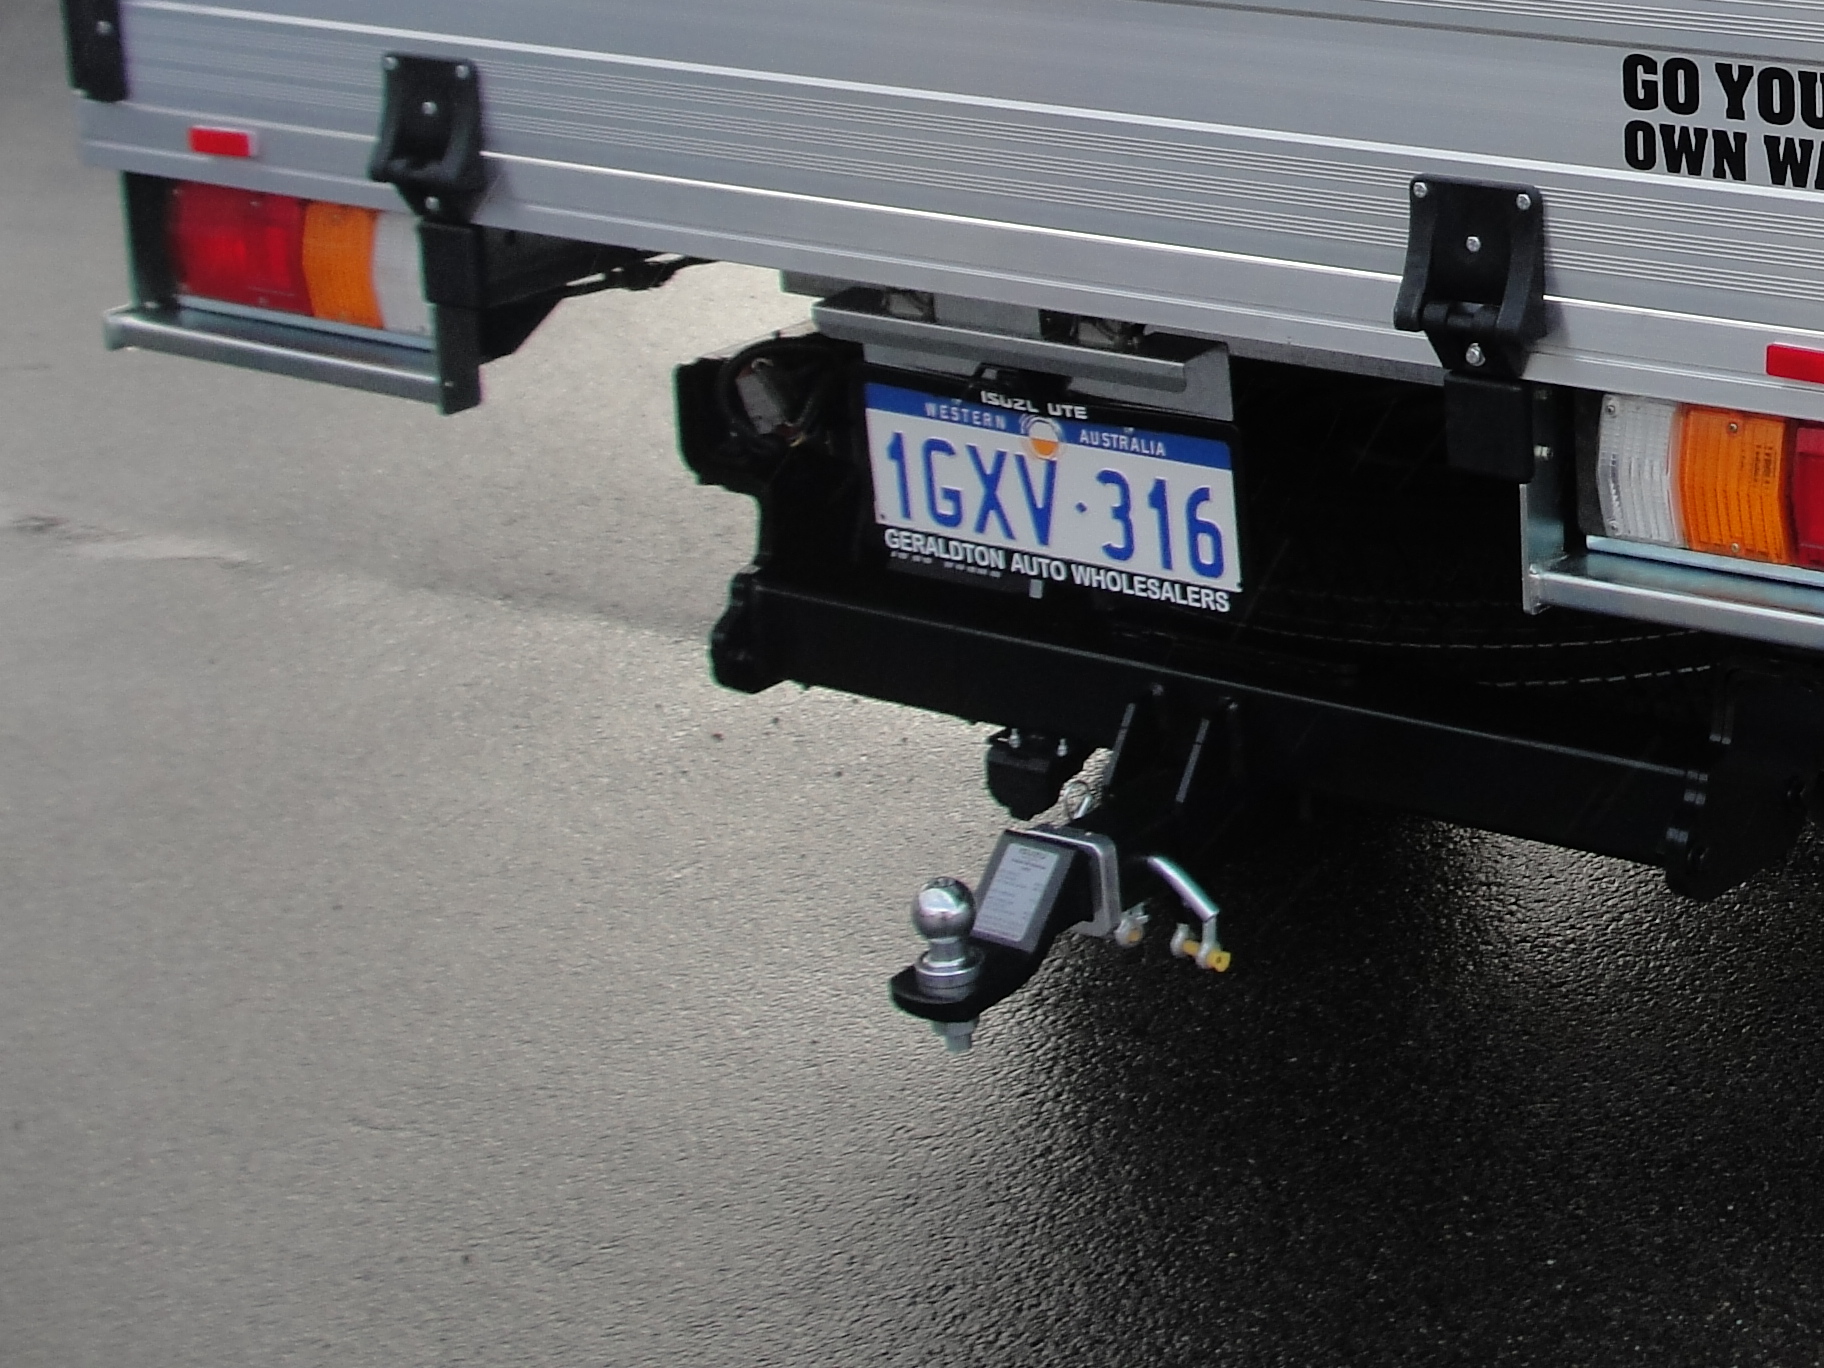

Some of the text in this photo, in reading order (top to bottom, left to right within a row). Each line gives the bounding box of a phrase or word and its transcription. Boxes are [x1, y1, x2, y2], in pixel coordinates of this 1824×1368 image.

[1622, 53, 1700, 116] GO
[1624, 119, 1747, 182] OWN
[924, 402, 1167, 457] WESTERN AUSTRALIA
[1047, 402, 1088, 420] UTE
[884, 527, 1231, 613] GERALDTON AUTO WHOLESALERS
